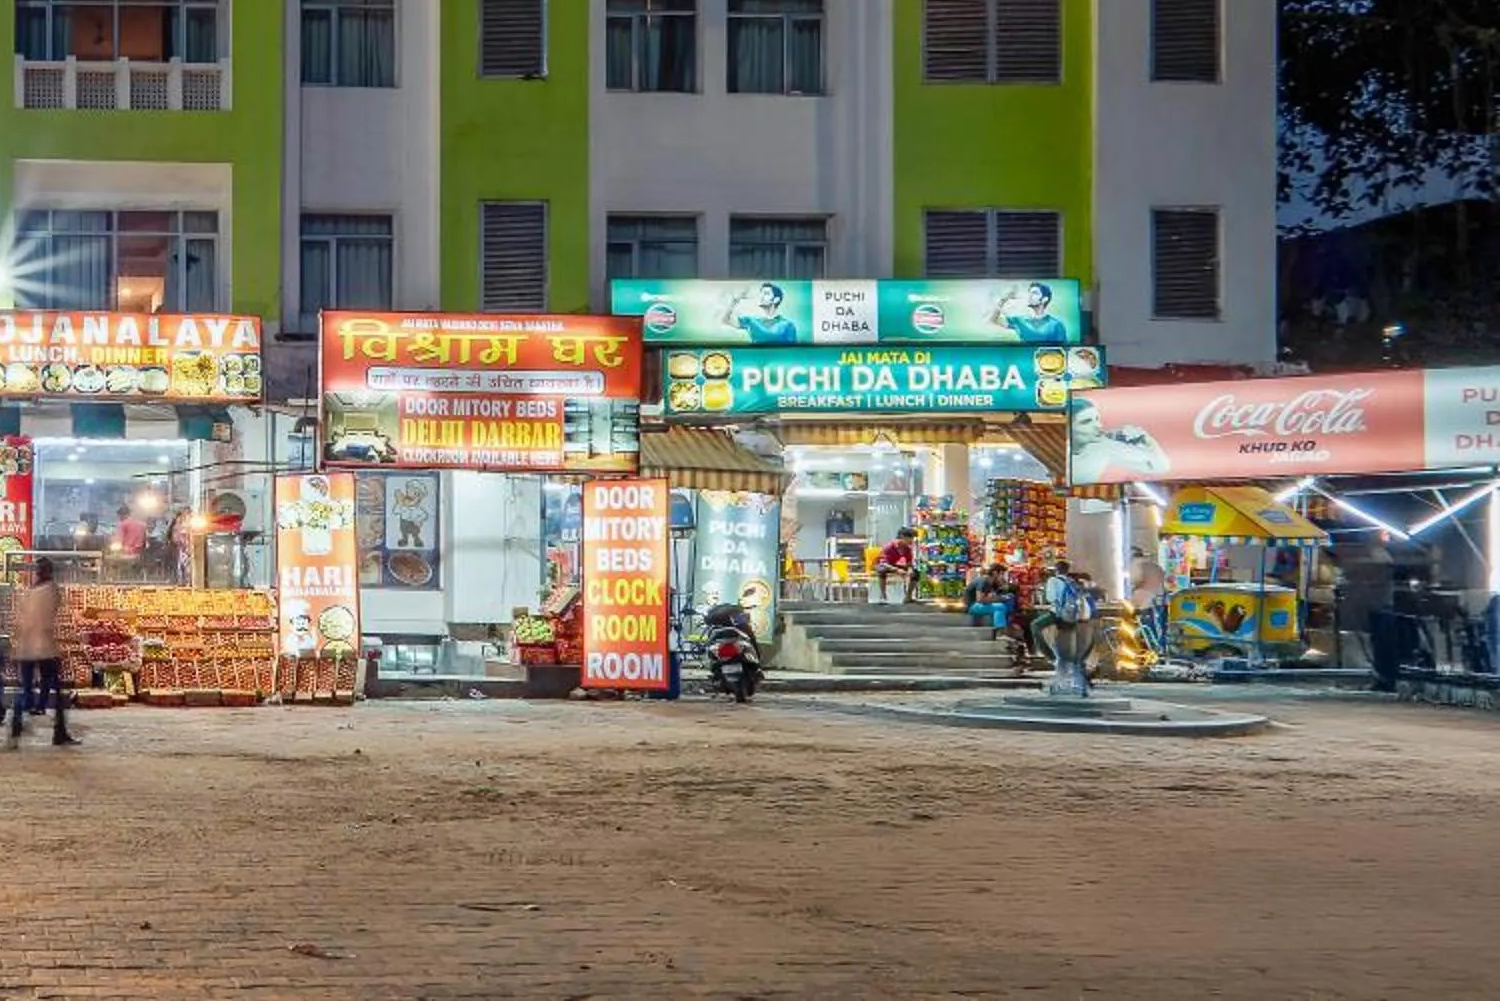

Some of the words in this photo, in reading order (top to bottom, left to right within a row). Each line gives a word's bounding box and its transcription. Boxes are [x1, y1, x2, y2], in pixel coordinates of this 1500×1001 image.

[825, 292, 865, 301] PUCHI
[821, 320, 871, 331] DHABA
[338, 319, 529, 366] विश्राम
[546, 335, 629, 367] घर
[838, 351, 862, 364] JAI
[867, 351, 909, 364] MATA
[914, 352, 931, 364] DI
[742, 366, 841, 392] PUCHI
[852, 365, 899, 391] DA
[908, 365, 1026, 391] DHABA
[406, 399, 449, 416] DOOR
[453, 399, 511, 417] MITORY
[516, 400, 557, 417] BEDS
[778, 395, 863, 407] BREAKFAST
[876, 395, 925, 407] LUNCH
[938, 395, 993, 407] DINNER
[1193, 388, 1375, 438] Coca-Cola
[403, 418, 464, 447] DELHI
[471, 420, 561, 448] DARBAR
[1239, 442, 1287, 453] KHUD
[1291, 440, 1316, 452] KO
[595, 486, 655, 509] DOOR
[585, 516, 663, 540] MITORY
[725, 539, 748, 556] DA
[596, 547, 652, 572] BEDS
[281, 566, 353, 586] HARI
[588, 579, 662, 606] CLOCK
[591, 615, 657, 642] ROOM
[587, 652, 663, 680] ROOM
